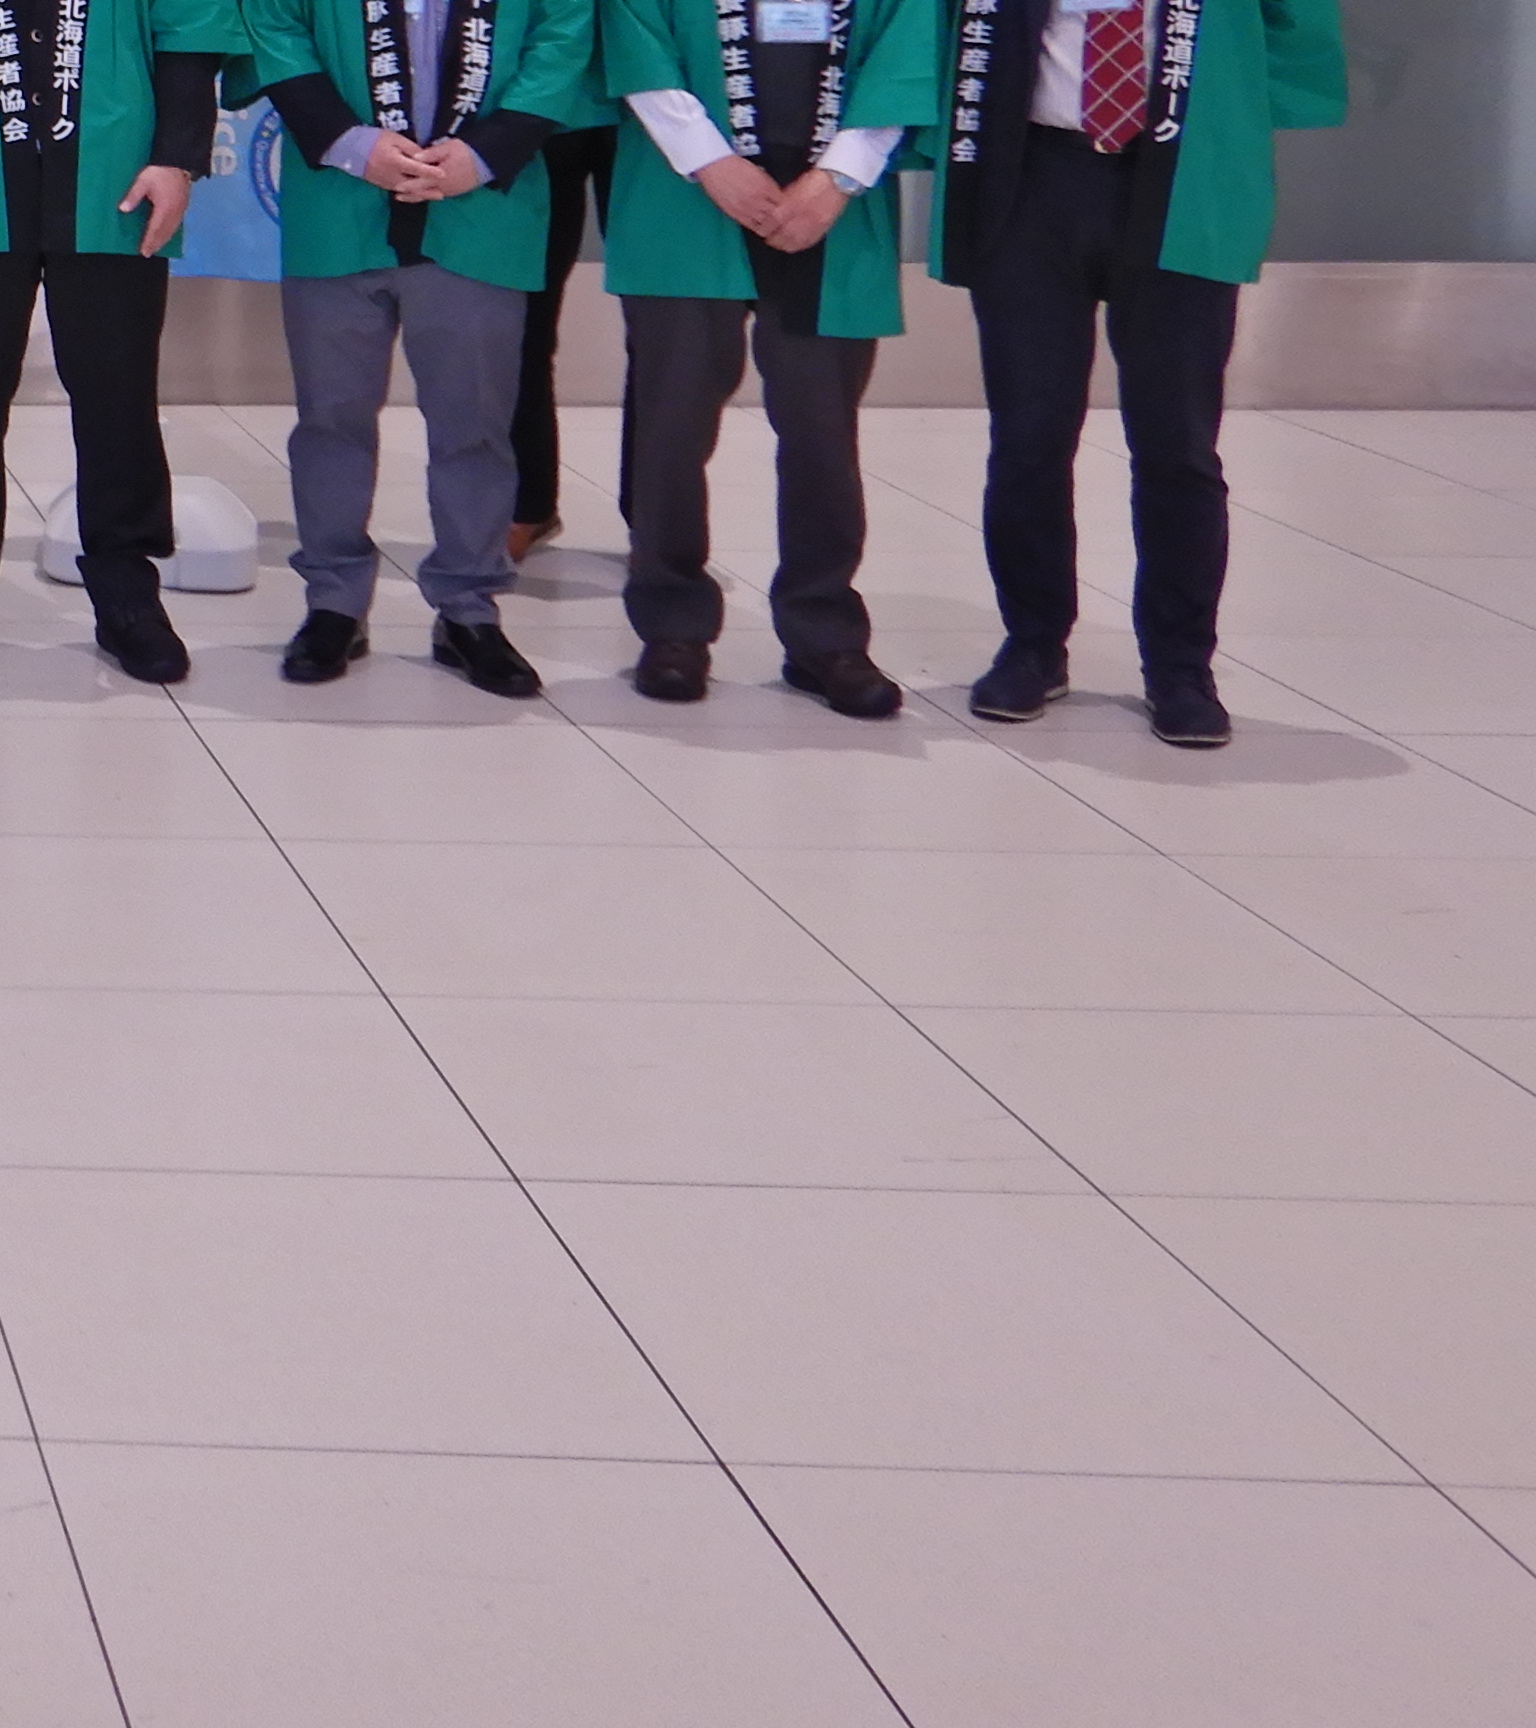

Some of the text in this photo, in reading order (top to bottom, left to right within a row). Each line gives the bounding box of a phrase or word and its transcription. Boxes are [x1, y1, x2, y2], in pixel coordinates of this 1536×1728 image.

[447, 18, 493, 136] 北海道ポー
